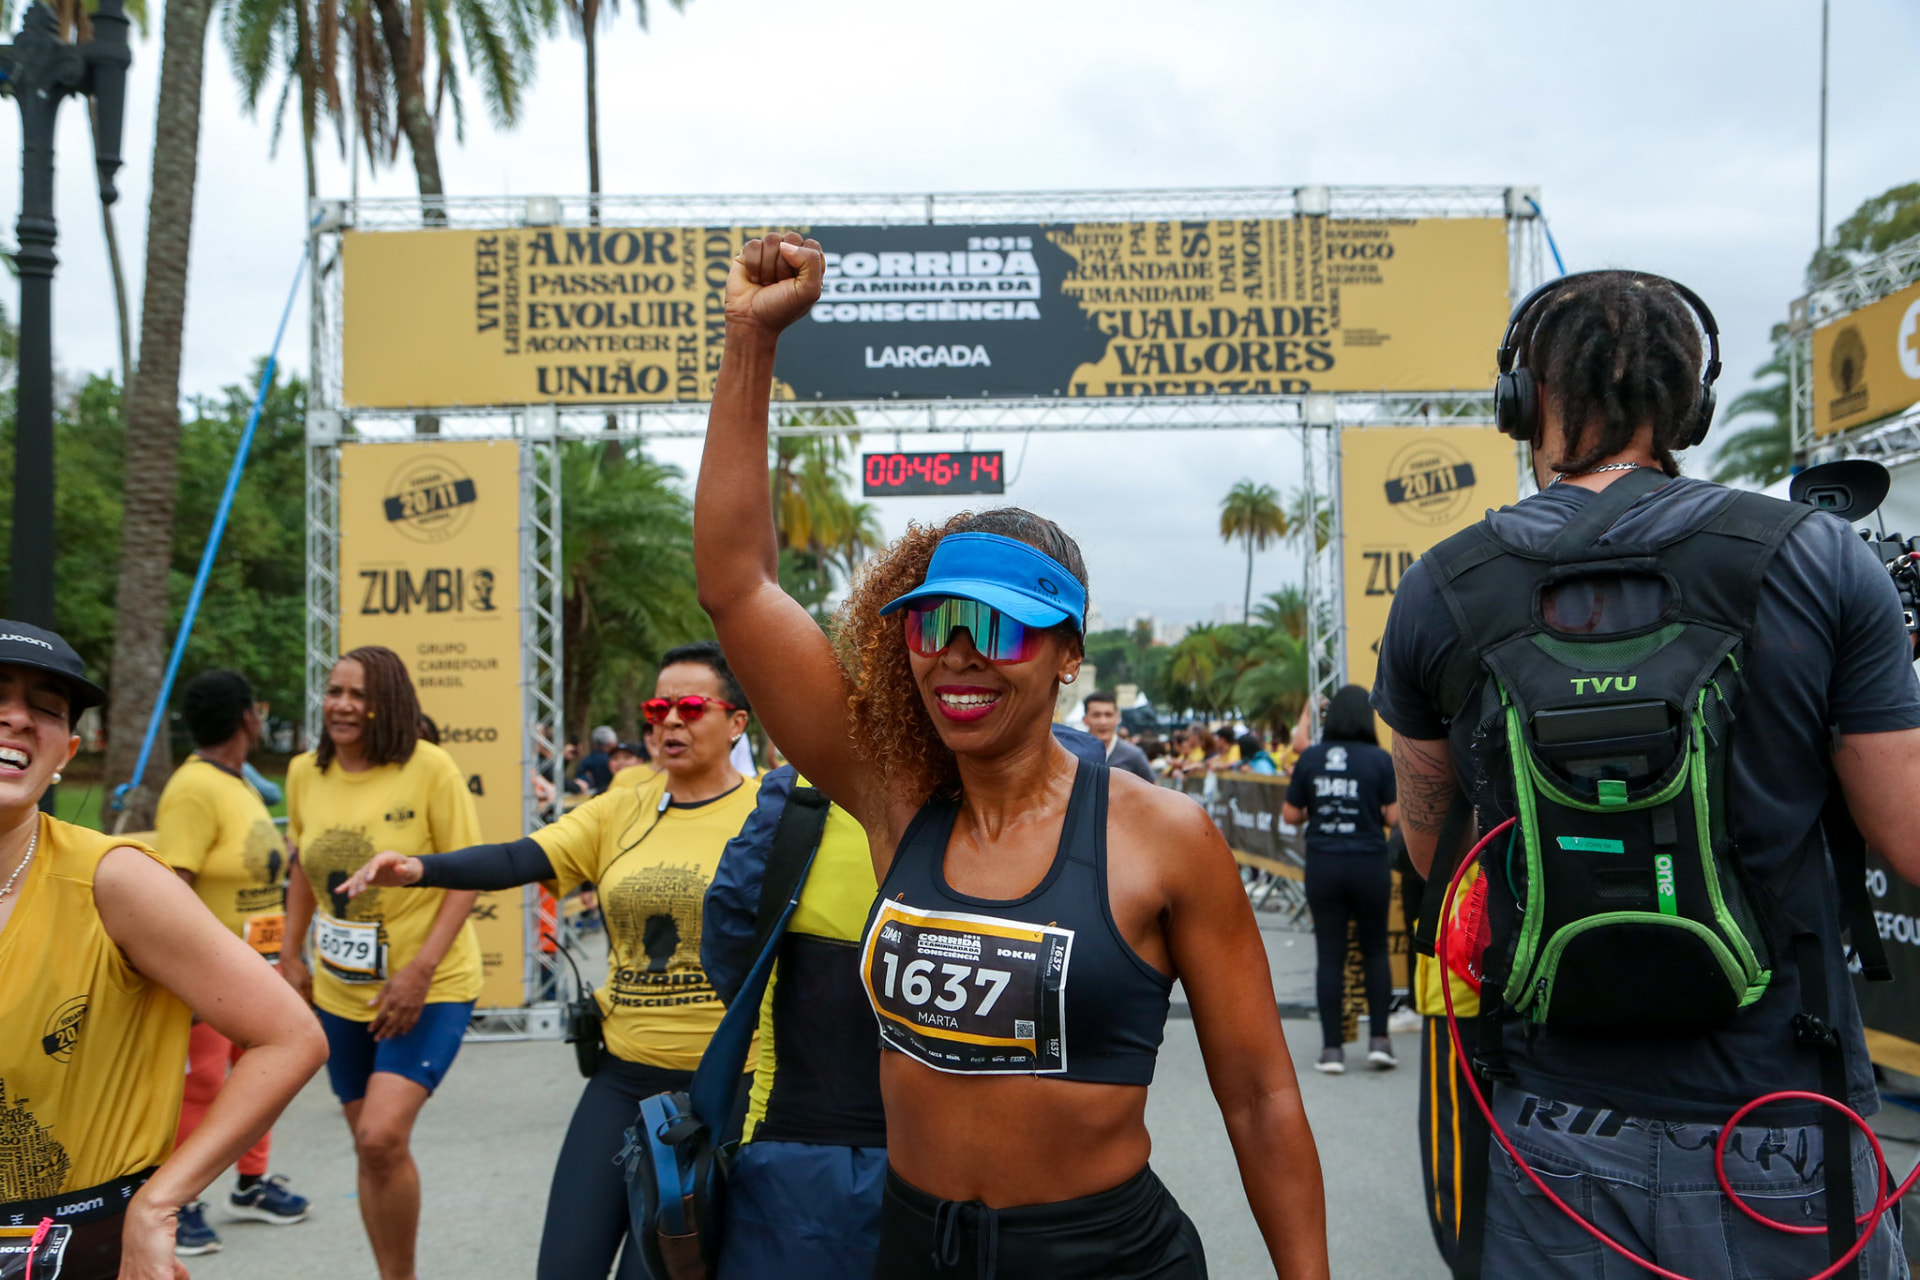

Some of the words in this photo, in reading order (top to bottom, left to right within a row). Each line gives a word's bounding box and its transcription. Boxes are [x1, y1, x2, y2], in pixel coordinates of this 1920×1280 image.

[527, 231, 678, 266] AMOR
[1327, 243, 1394, 261] FOCO
[823, 251, 1040, 277] CORRIDA
[477, 233, 499, 335] VIVER
[529, 272, 675, 295] PASSADO
[835, 280, 992, 293] CAMINHADA
[997, 280, 1032, 292] DA
[528, 301, 698, 329] EVOLUIR
[811, 299, 1041, 322] CONSCIÊNCIA
[1090, 305, 1330, 340] GUALDADE
[525, 334, 671, 353] ACONTECER
[865, 345, 991, 368] LARGADA
[1113, 339, 1336, 377] VALORES
[537, 358, 669, 396] UNIÃO
[1400, 467, 1459, 500] 20/11
[400, 483, 460, 516] 20/11
[358, 567, 464, 616] ZUMBI
[417, 659, 499, 672] CARREFOUR
[1570, 675, 1637, 695] TVU
[439, 725, 498, 743] desco
[1656, 856, 1675, 897] one
[918, 933, 982, 948] CORRIDA
[917, 947, 980, 962] CONSCIÊNCIA
[997, 948, 1037, 961] 10KM
[1053, 945, 1065, 972] 1637
[883, 951, 1012, 1017] 1637
[917, 1011, 959, 1029] MARTA
[1050, 1038, 1060, 1058] 1637
